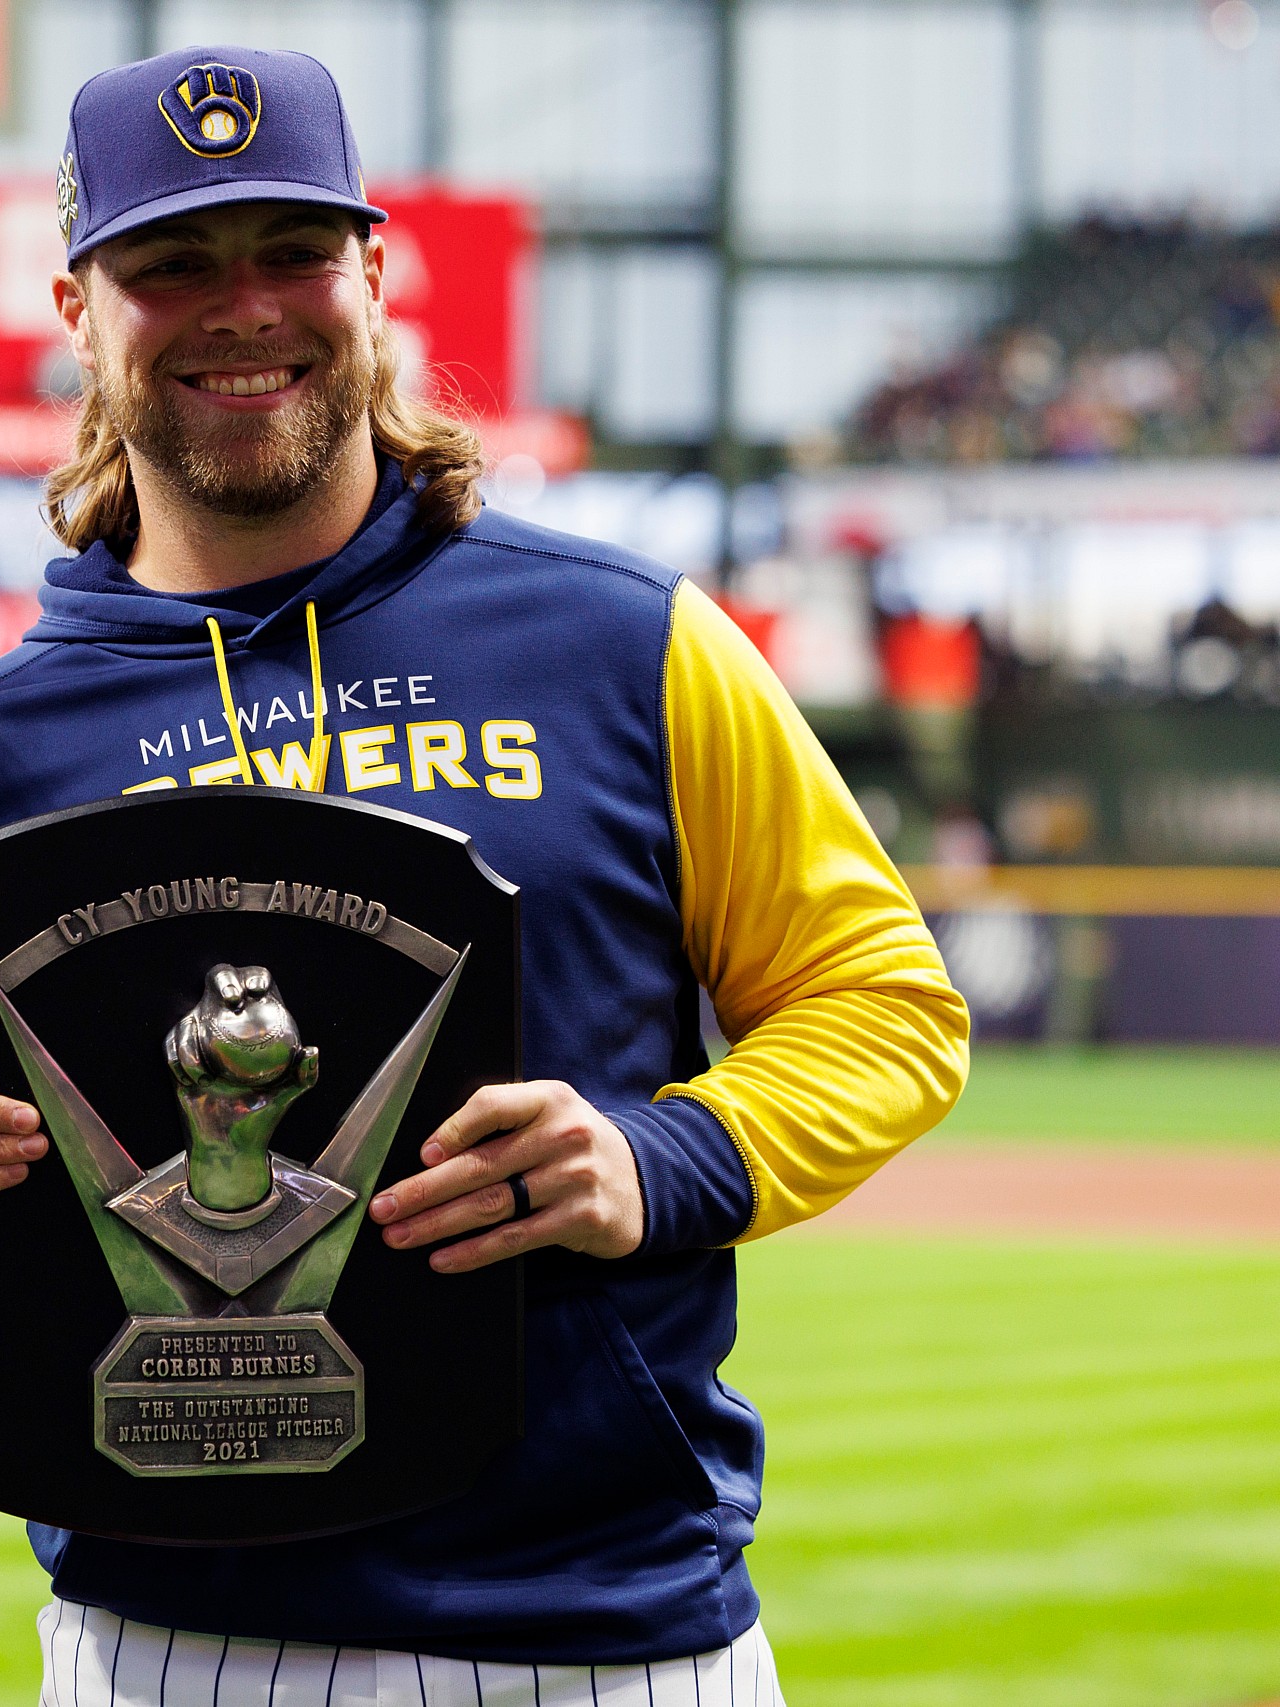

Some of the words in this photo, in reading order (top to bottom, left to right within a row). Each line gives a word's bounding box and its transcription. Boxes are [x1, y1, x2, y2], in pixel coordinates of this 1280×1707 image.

[139, 675, 436, 765] MILWAUKEE
[57, 903, 101, 946] CY
[122, 877, 240, 921] YOUNG
[267, 881, 388, 936] AWARD
[161, 1335, 265, 1354] PRESENTED
[276, 1335, 297, 1351] TO
[141, 1358, 222, 1378] CORBIN
[231, 1354, 316, 1377] BURNES
[138, 1401, 175, 1419] THE
[185, 1397, 309, 1417] OUTSTANDING
[118, 1424, 201, 1443] NATIONAL
[205, 1421, 268, 1440] LEAGUE
[276, 1418, 344, 1438] PITCHER
[203, 1441, 260, 1461] 2021
